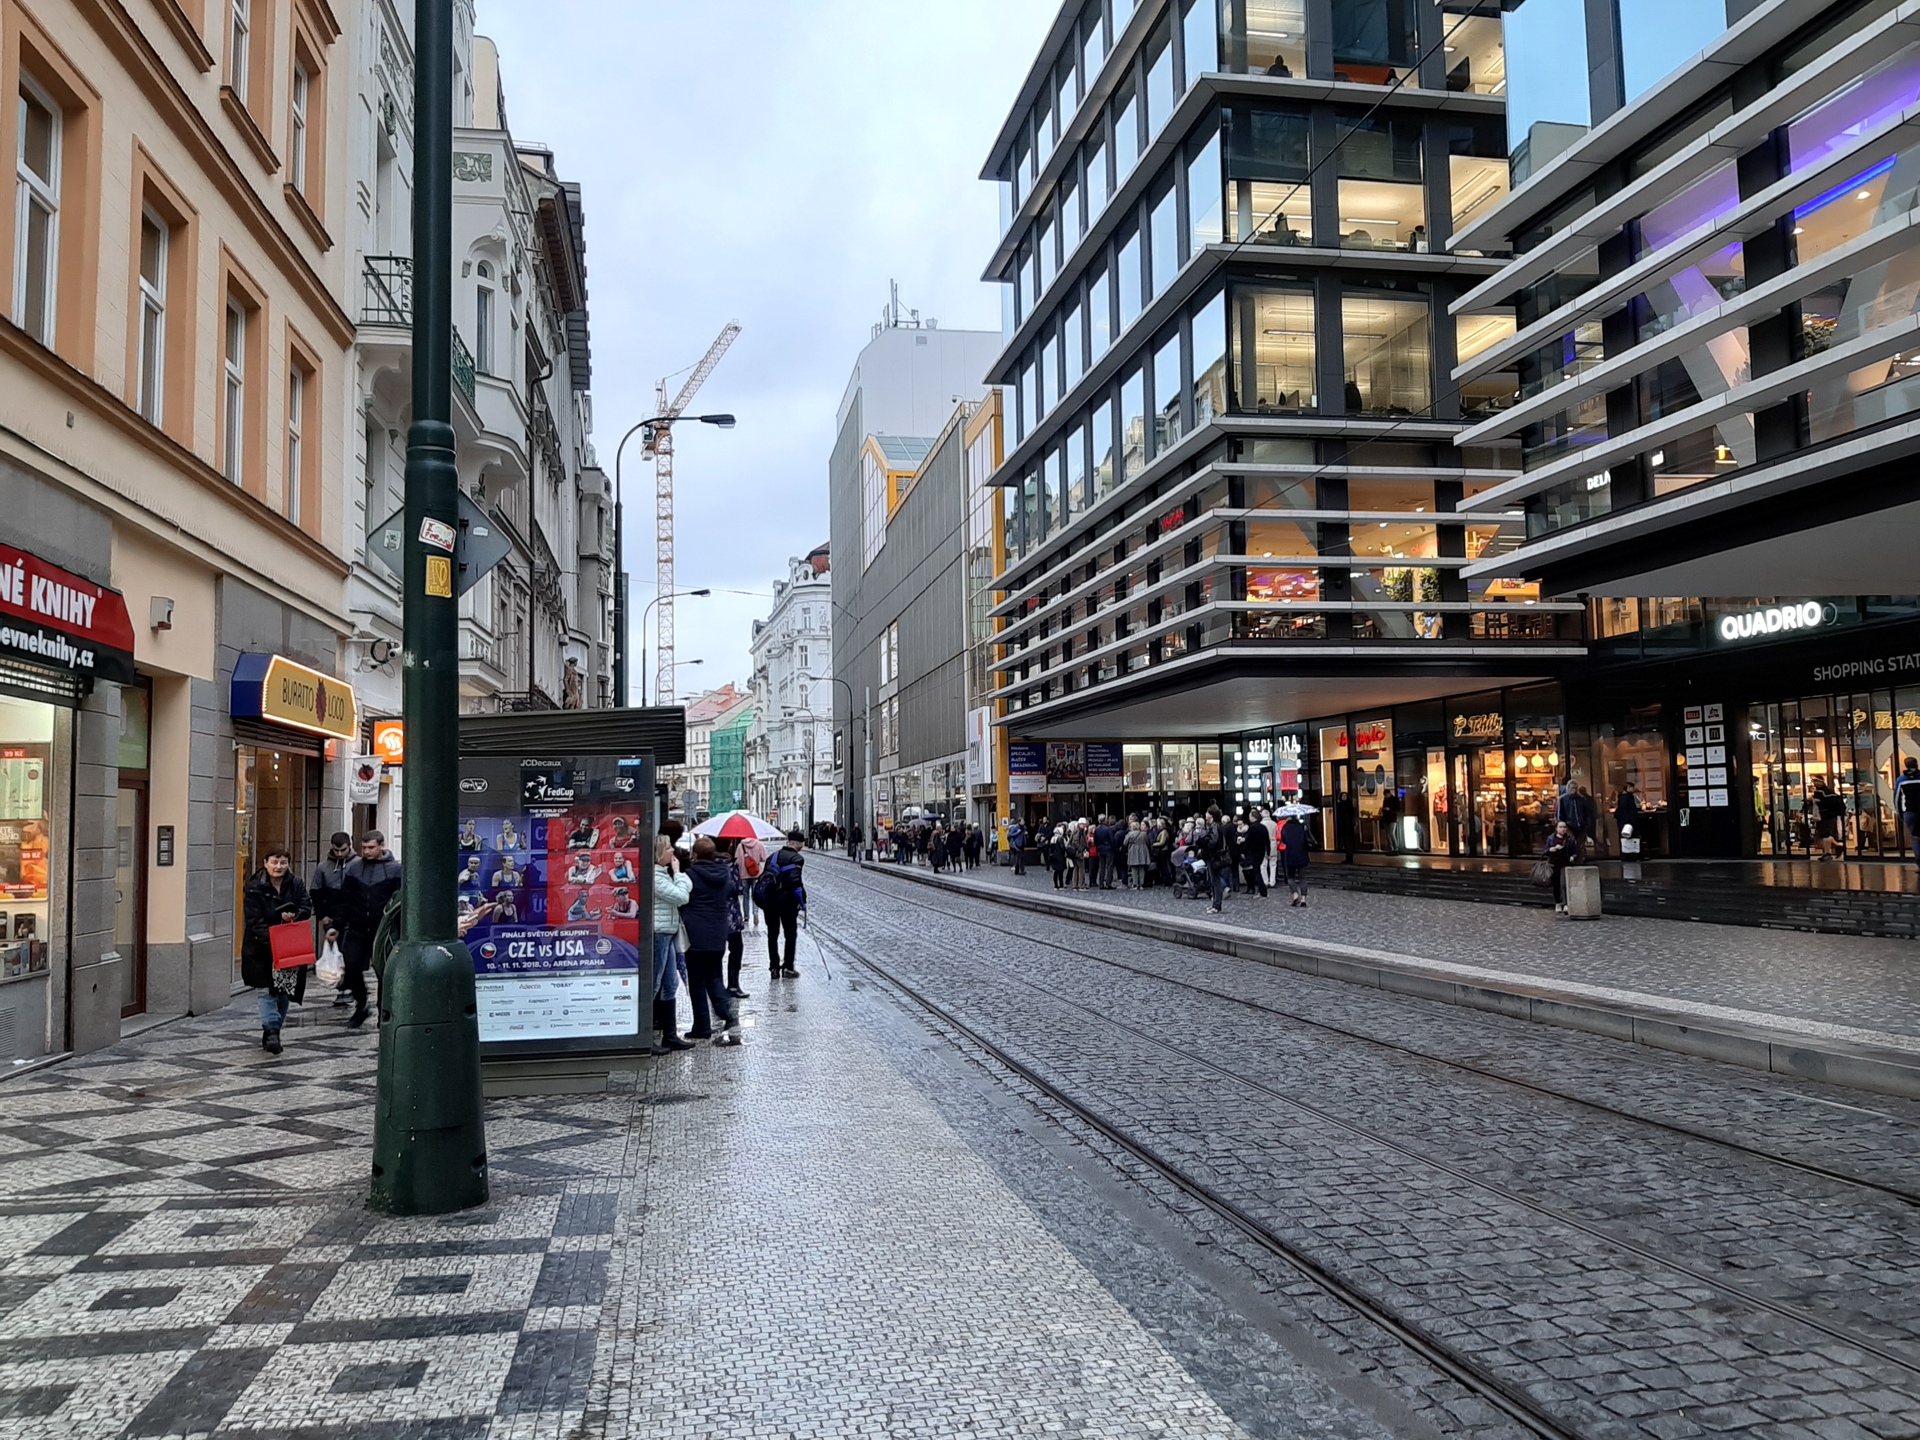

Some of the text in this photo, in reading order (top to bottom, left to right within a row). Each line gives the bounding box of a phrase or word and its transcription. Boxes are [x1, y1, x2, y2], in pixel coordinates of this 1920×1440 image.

[30, 574, 96, 629] KNIHY
[1721, 601, 1822, 640] QUADRIO
[0, 626, 94, 668] evneknihy.cz
[1814, 653, 1920, 681] SHOPPING STAT
[282, 677, 345, 722] BURRITO LOCO
[520, 759, 562, 767] JCDecaux
[502, 931, 526, 939] FINÁLE
[527, 930, 559, 938] SVĚTOVÉ
[508, 941, 535, 958] CZE
[555, 940, 585, 956] USA
